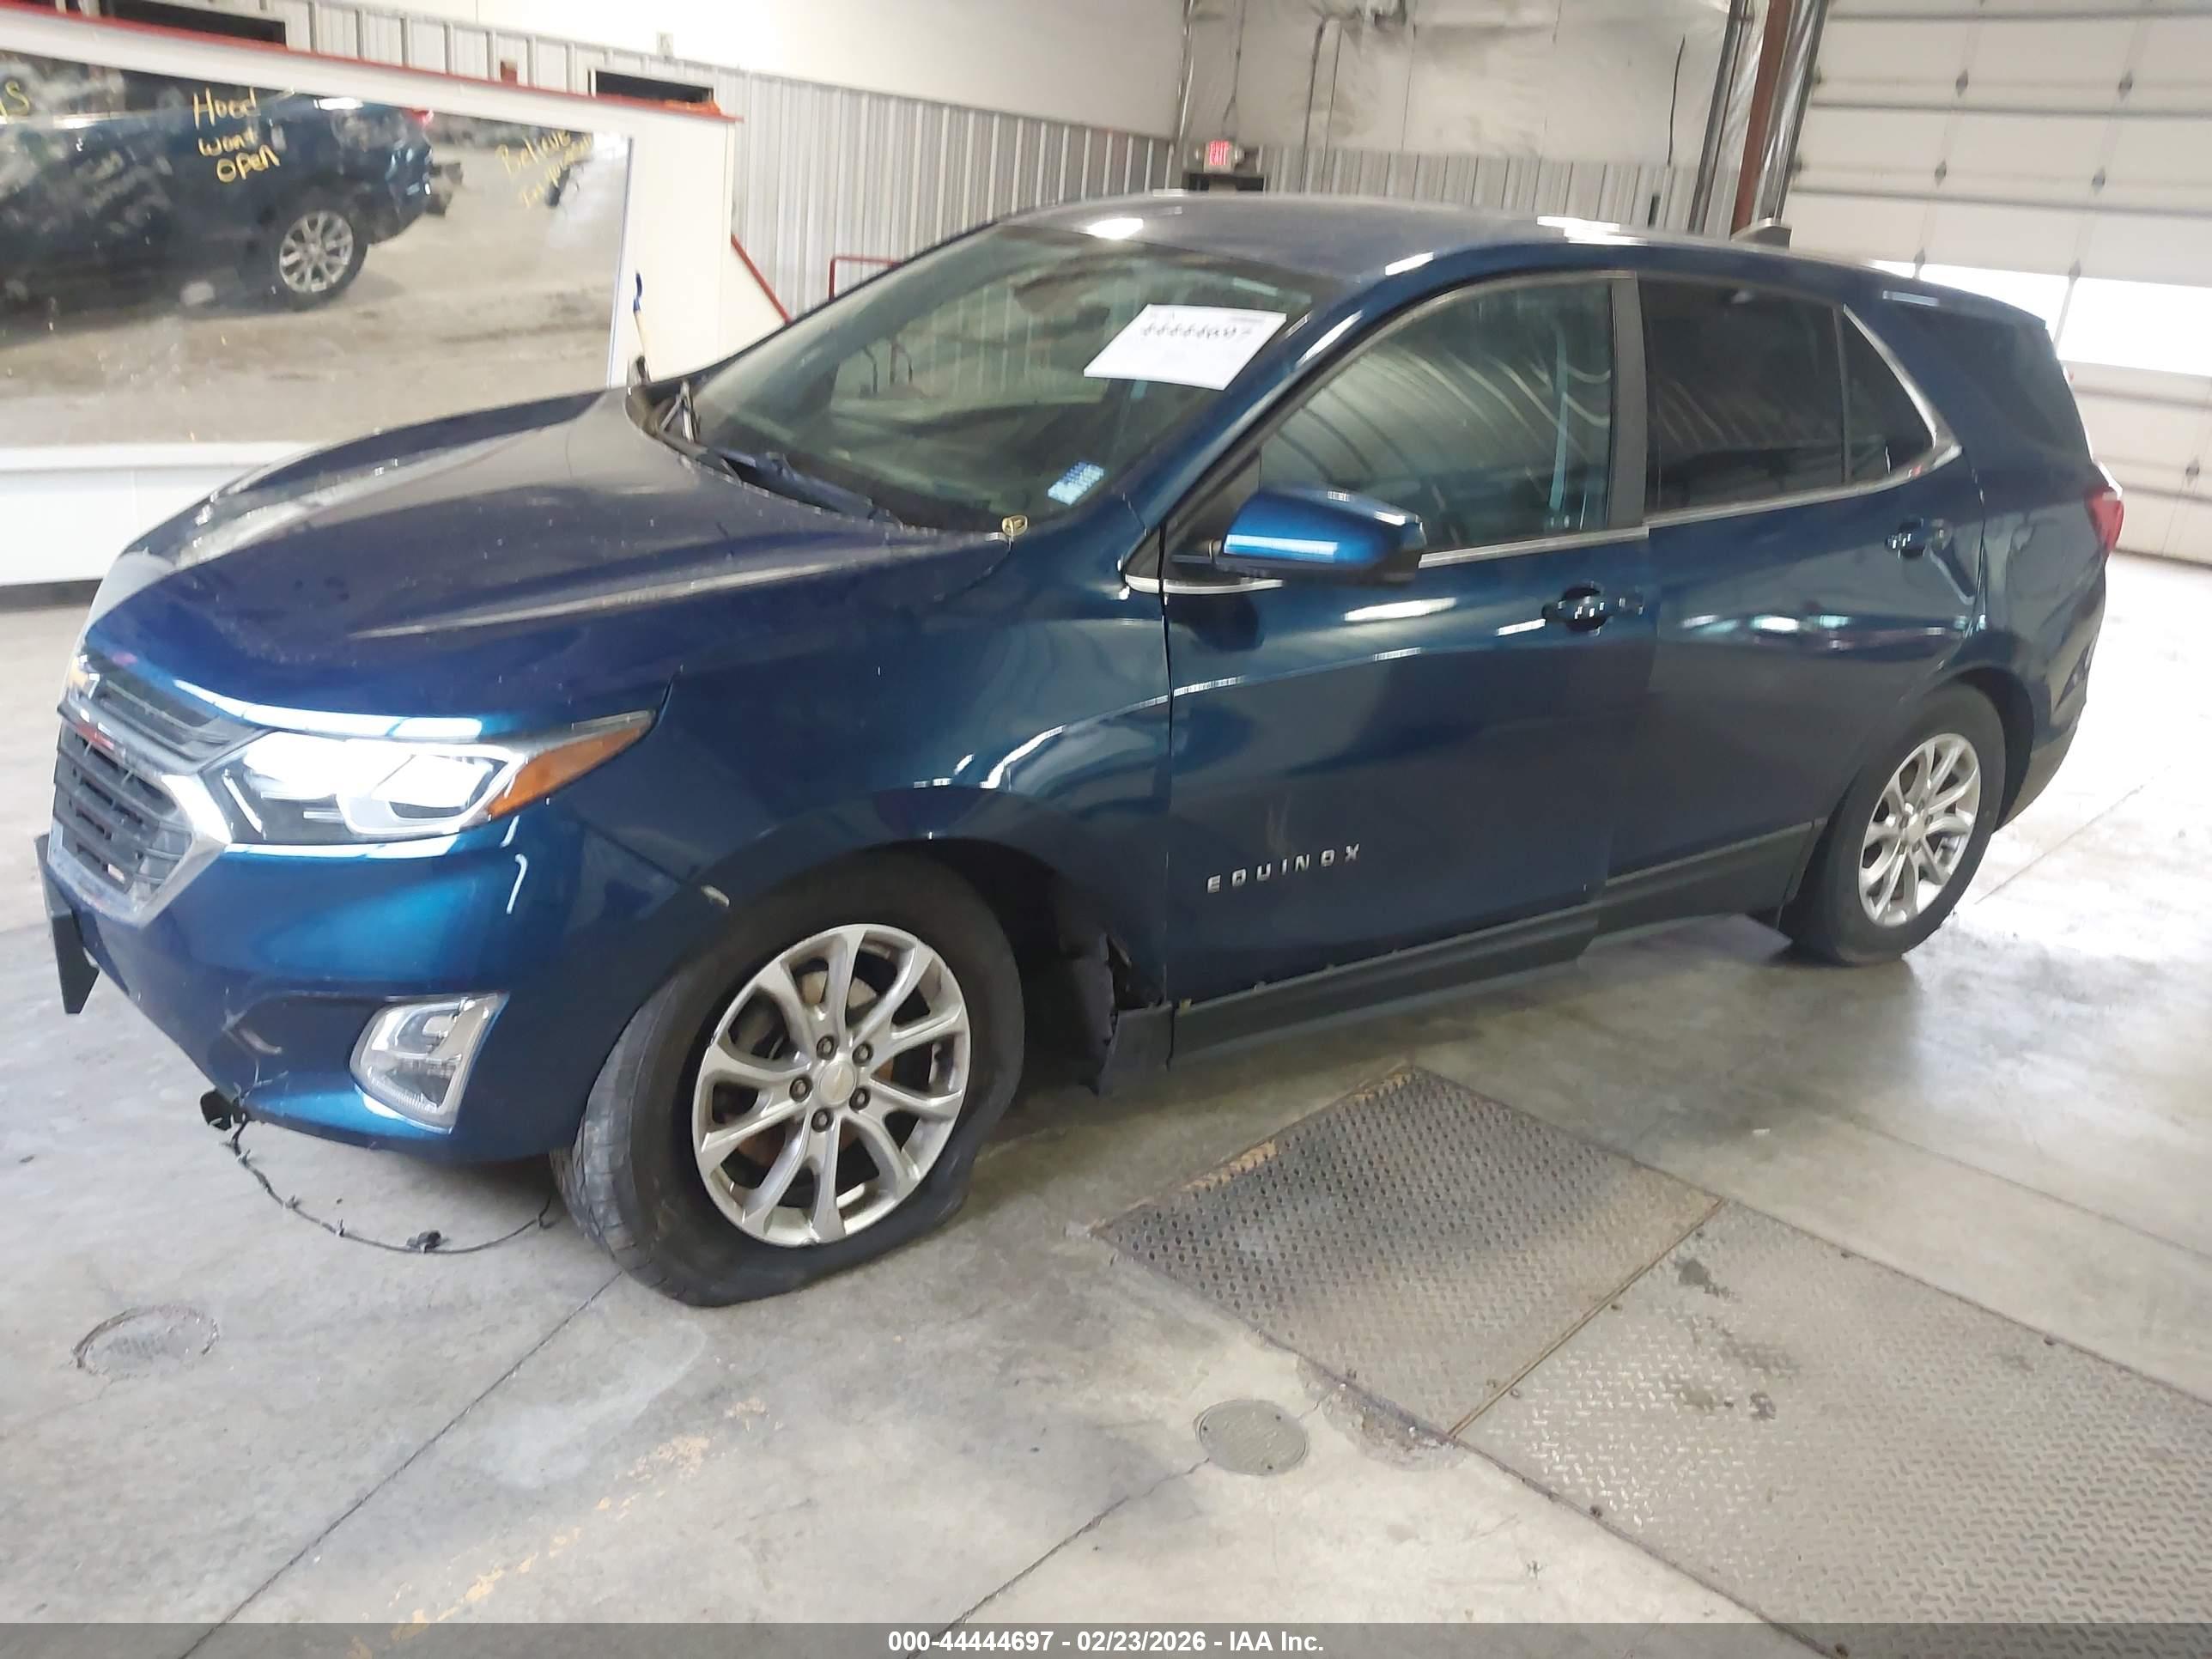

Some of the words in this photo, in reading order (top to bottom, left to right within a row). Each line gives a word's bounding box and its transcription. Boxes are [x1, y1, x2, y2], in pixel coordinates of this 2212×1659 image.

[193, 87, 260, 131] Hood
[1209, 139, 1229, 166] EXIT
[1206, 842, 1361, 894] EQUINOX
